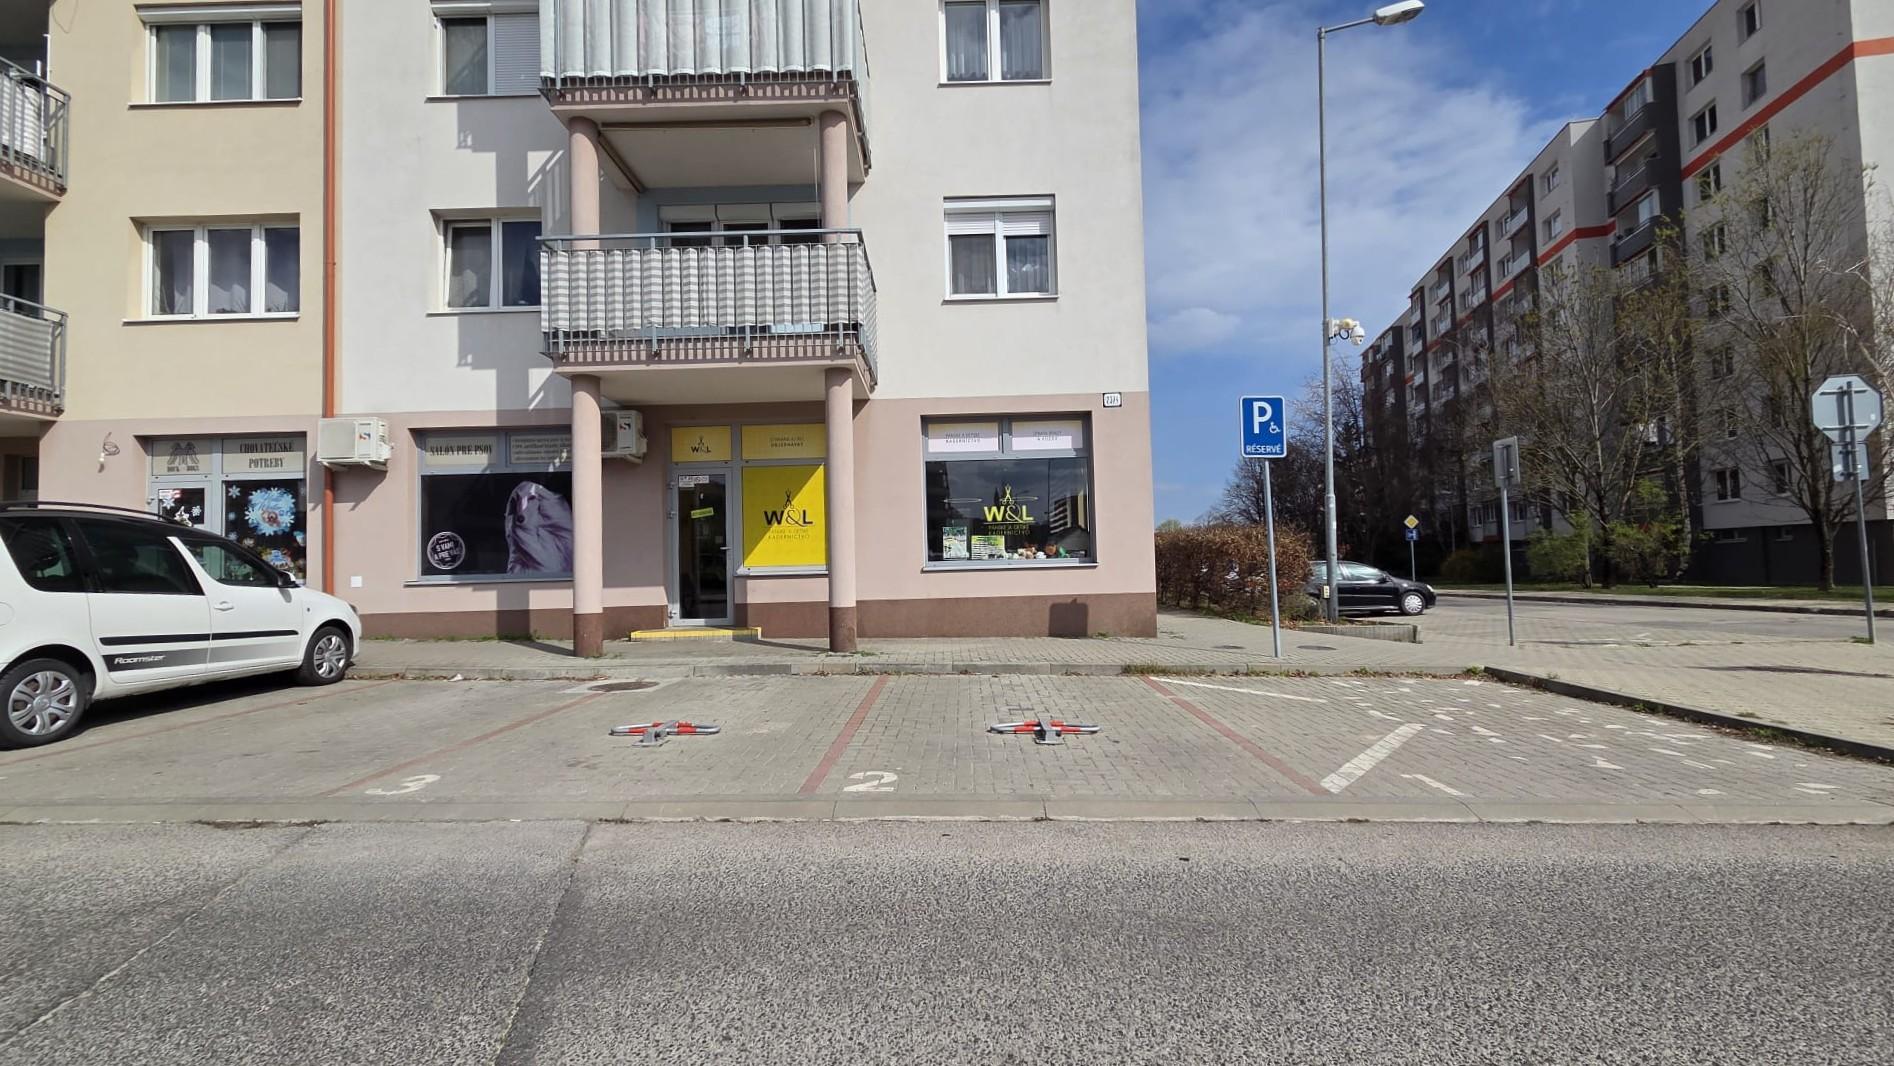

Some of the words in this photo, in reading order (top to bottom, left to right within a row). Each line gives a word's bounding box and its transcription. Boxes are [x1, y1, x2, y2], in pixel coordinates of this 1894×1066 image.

[1253, 401, 1272, 434] P
[456, 444, 473, 455] PRE
[1246, 443, 1282, 453] RÉSERVÉ
[763, 508, 814, 527] W&L
[983, 504, 1035, 523] W&L
[114, 656, 166, 664] Roomster
[364, 774, 441, 795] 3
[842, 771, 899, 792] 2
